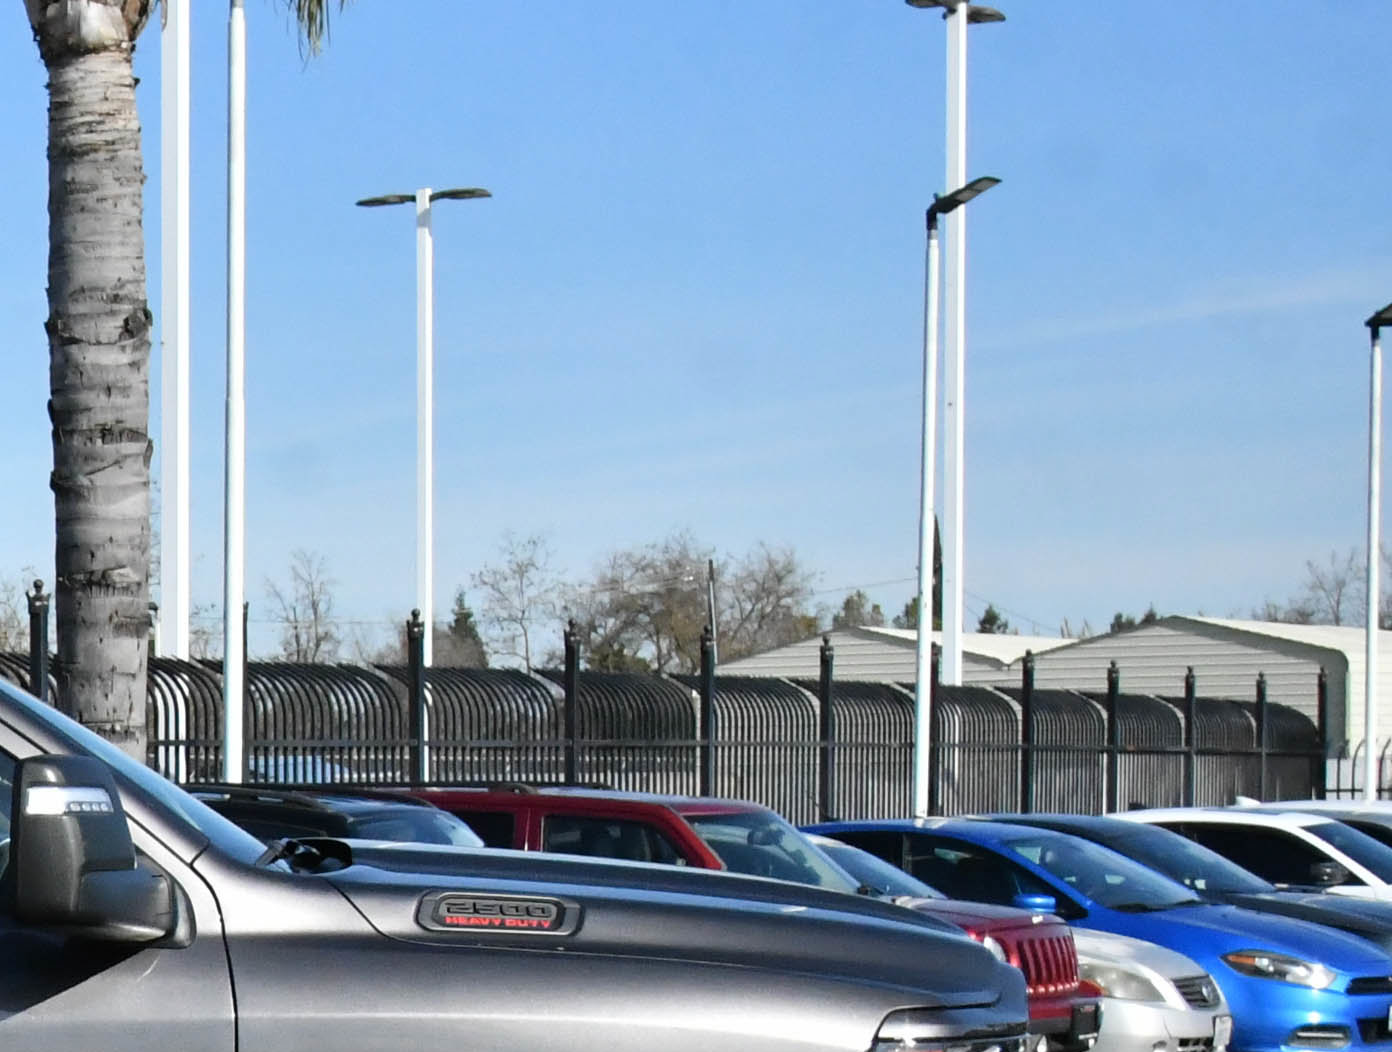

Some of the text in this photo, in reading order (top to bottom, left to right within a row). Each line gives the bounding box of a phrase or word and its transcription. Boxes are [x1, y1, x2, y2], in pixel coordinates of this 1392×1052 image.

[444, 901, 553, 918] 2500
[445, 915, 552, 929] HEAVY DUTY
